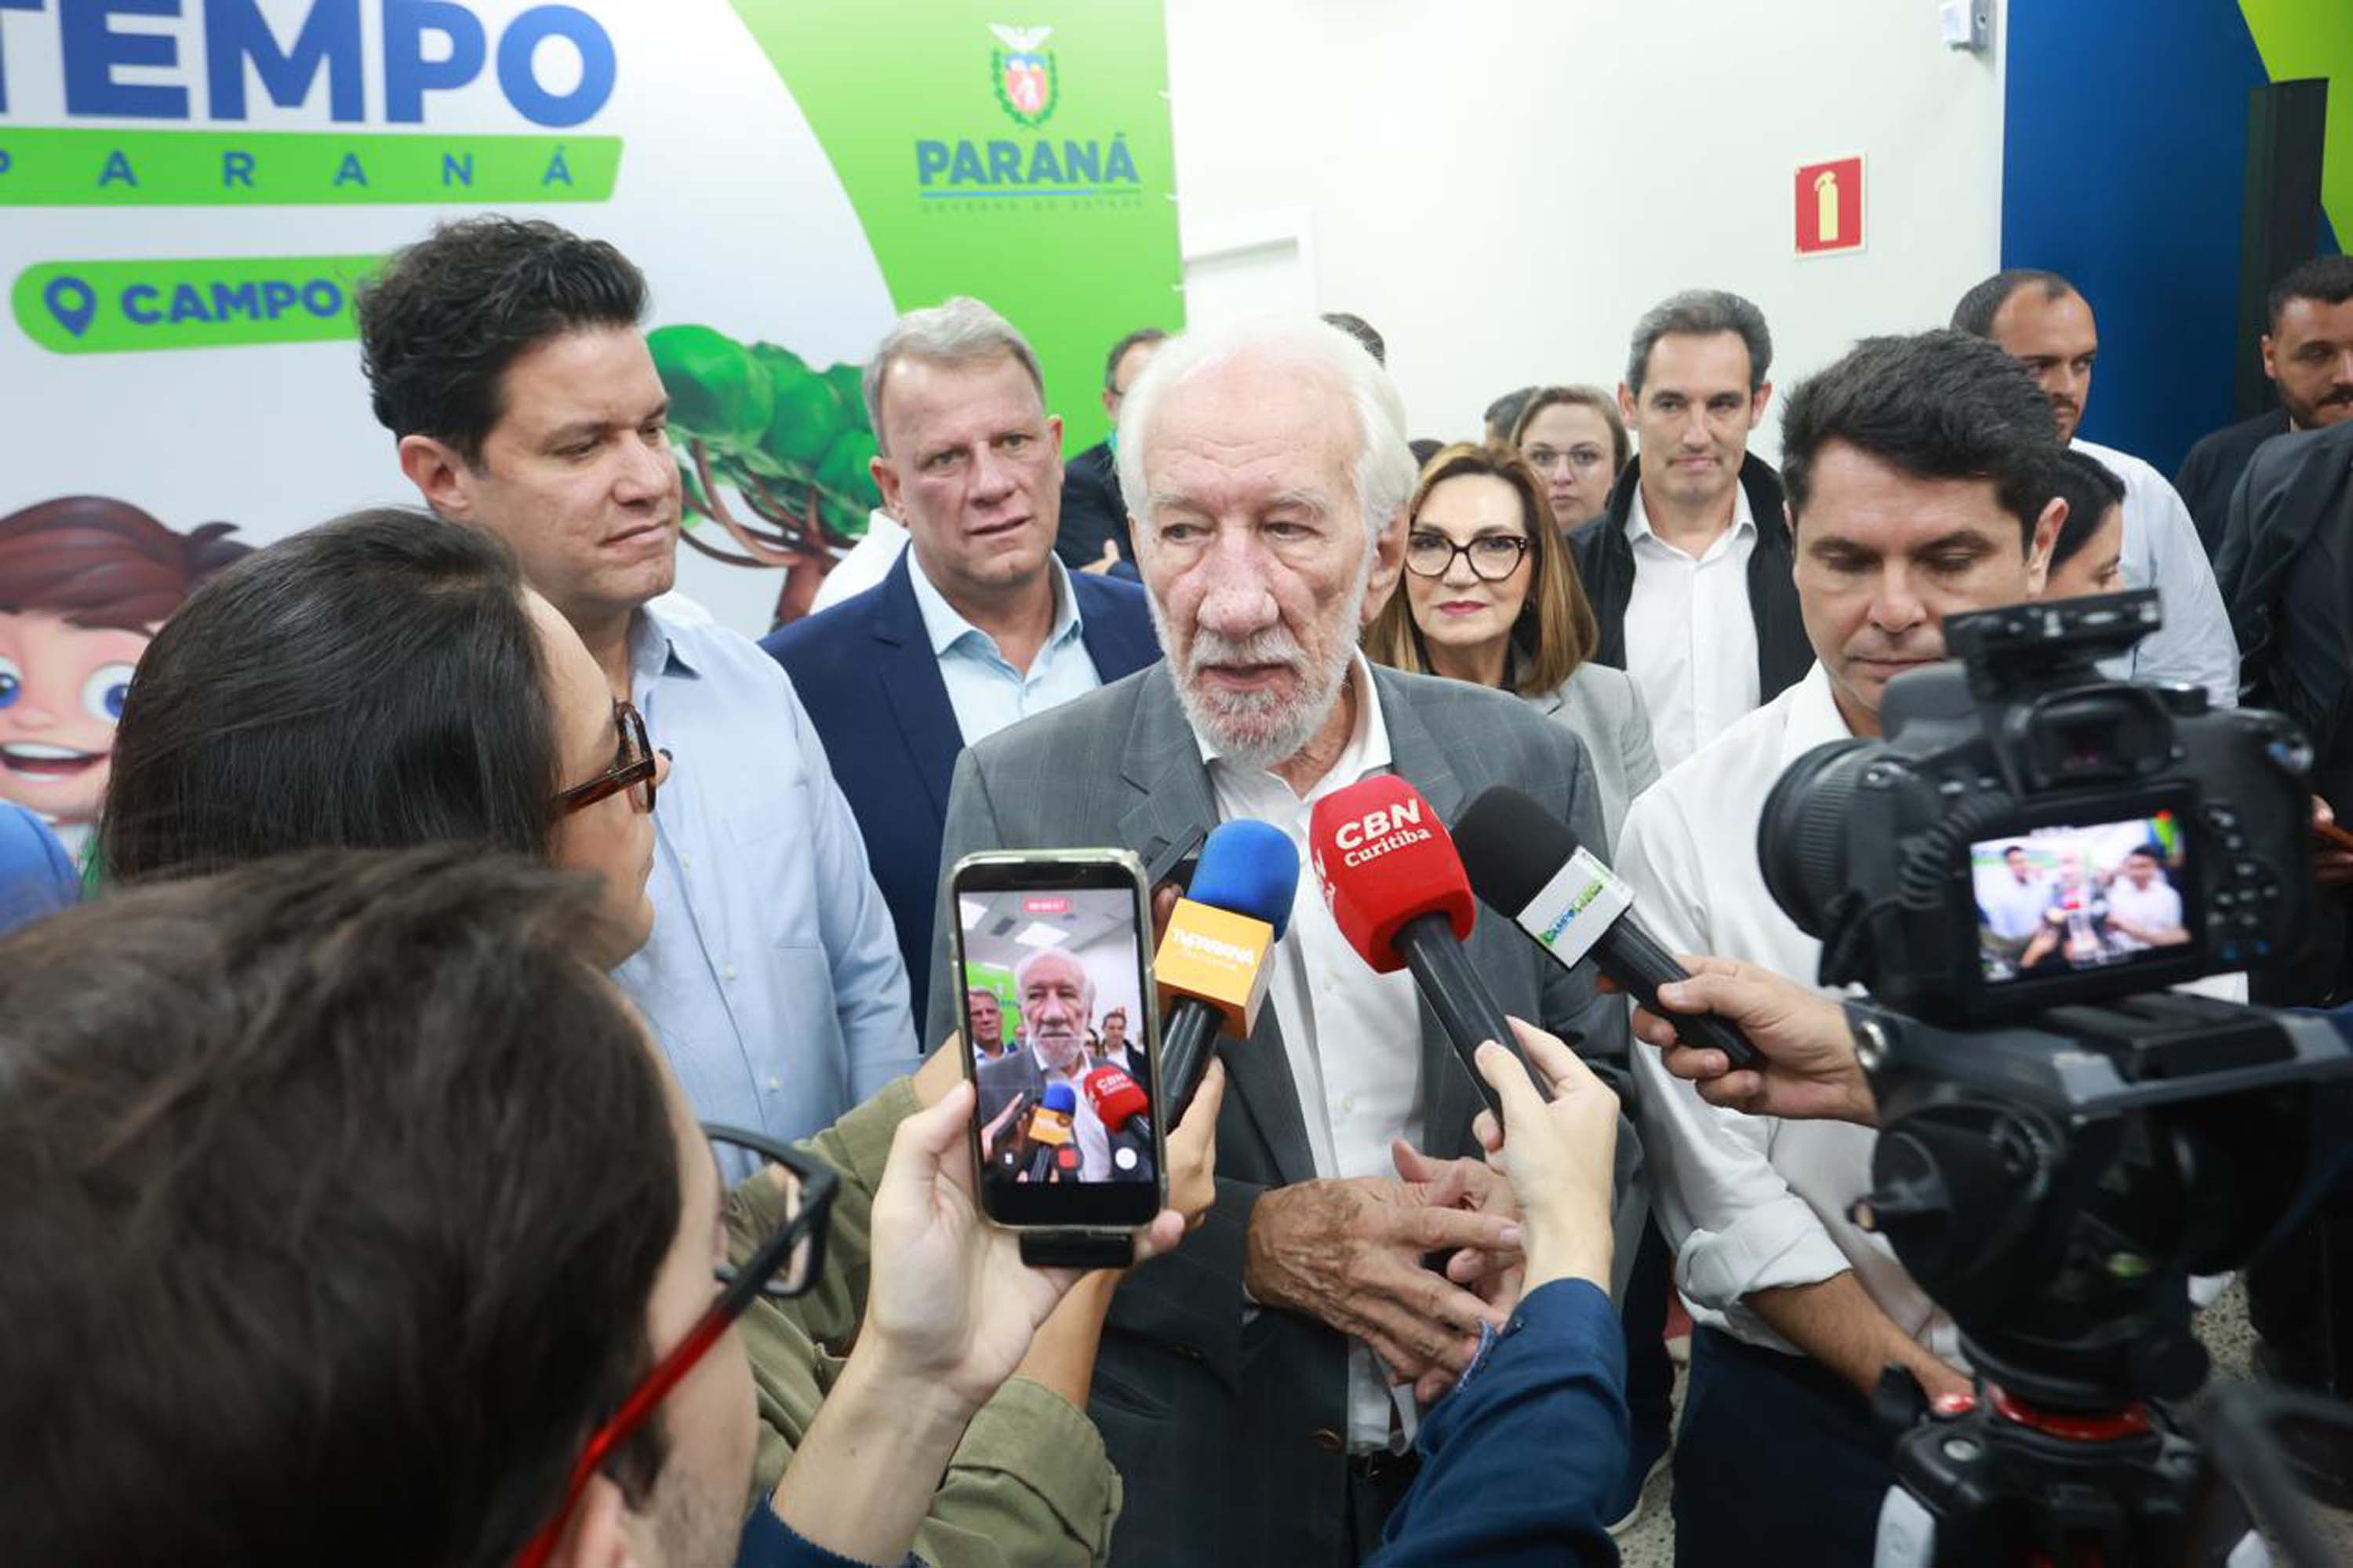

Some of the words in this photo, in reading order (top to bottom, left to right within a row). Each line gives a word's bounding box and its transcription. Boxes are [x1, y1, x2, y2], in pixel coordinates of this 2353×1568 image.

[915, 132, 1141, 185] PARANÁ
[120, 278, 343, 325] CAMPO
[1335, 798, 1423, 850] CBN
[1344, 828, 1432, 868] Curitiba
